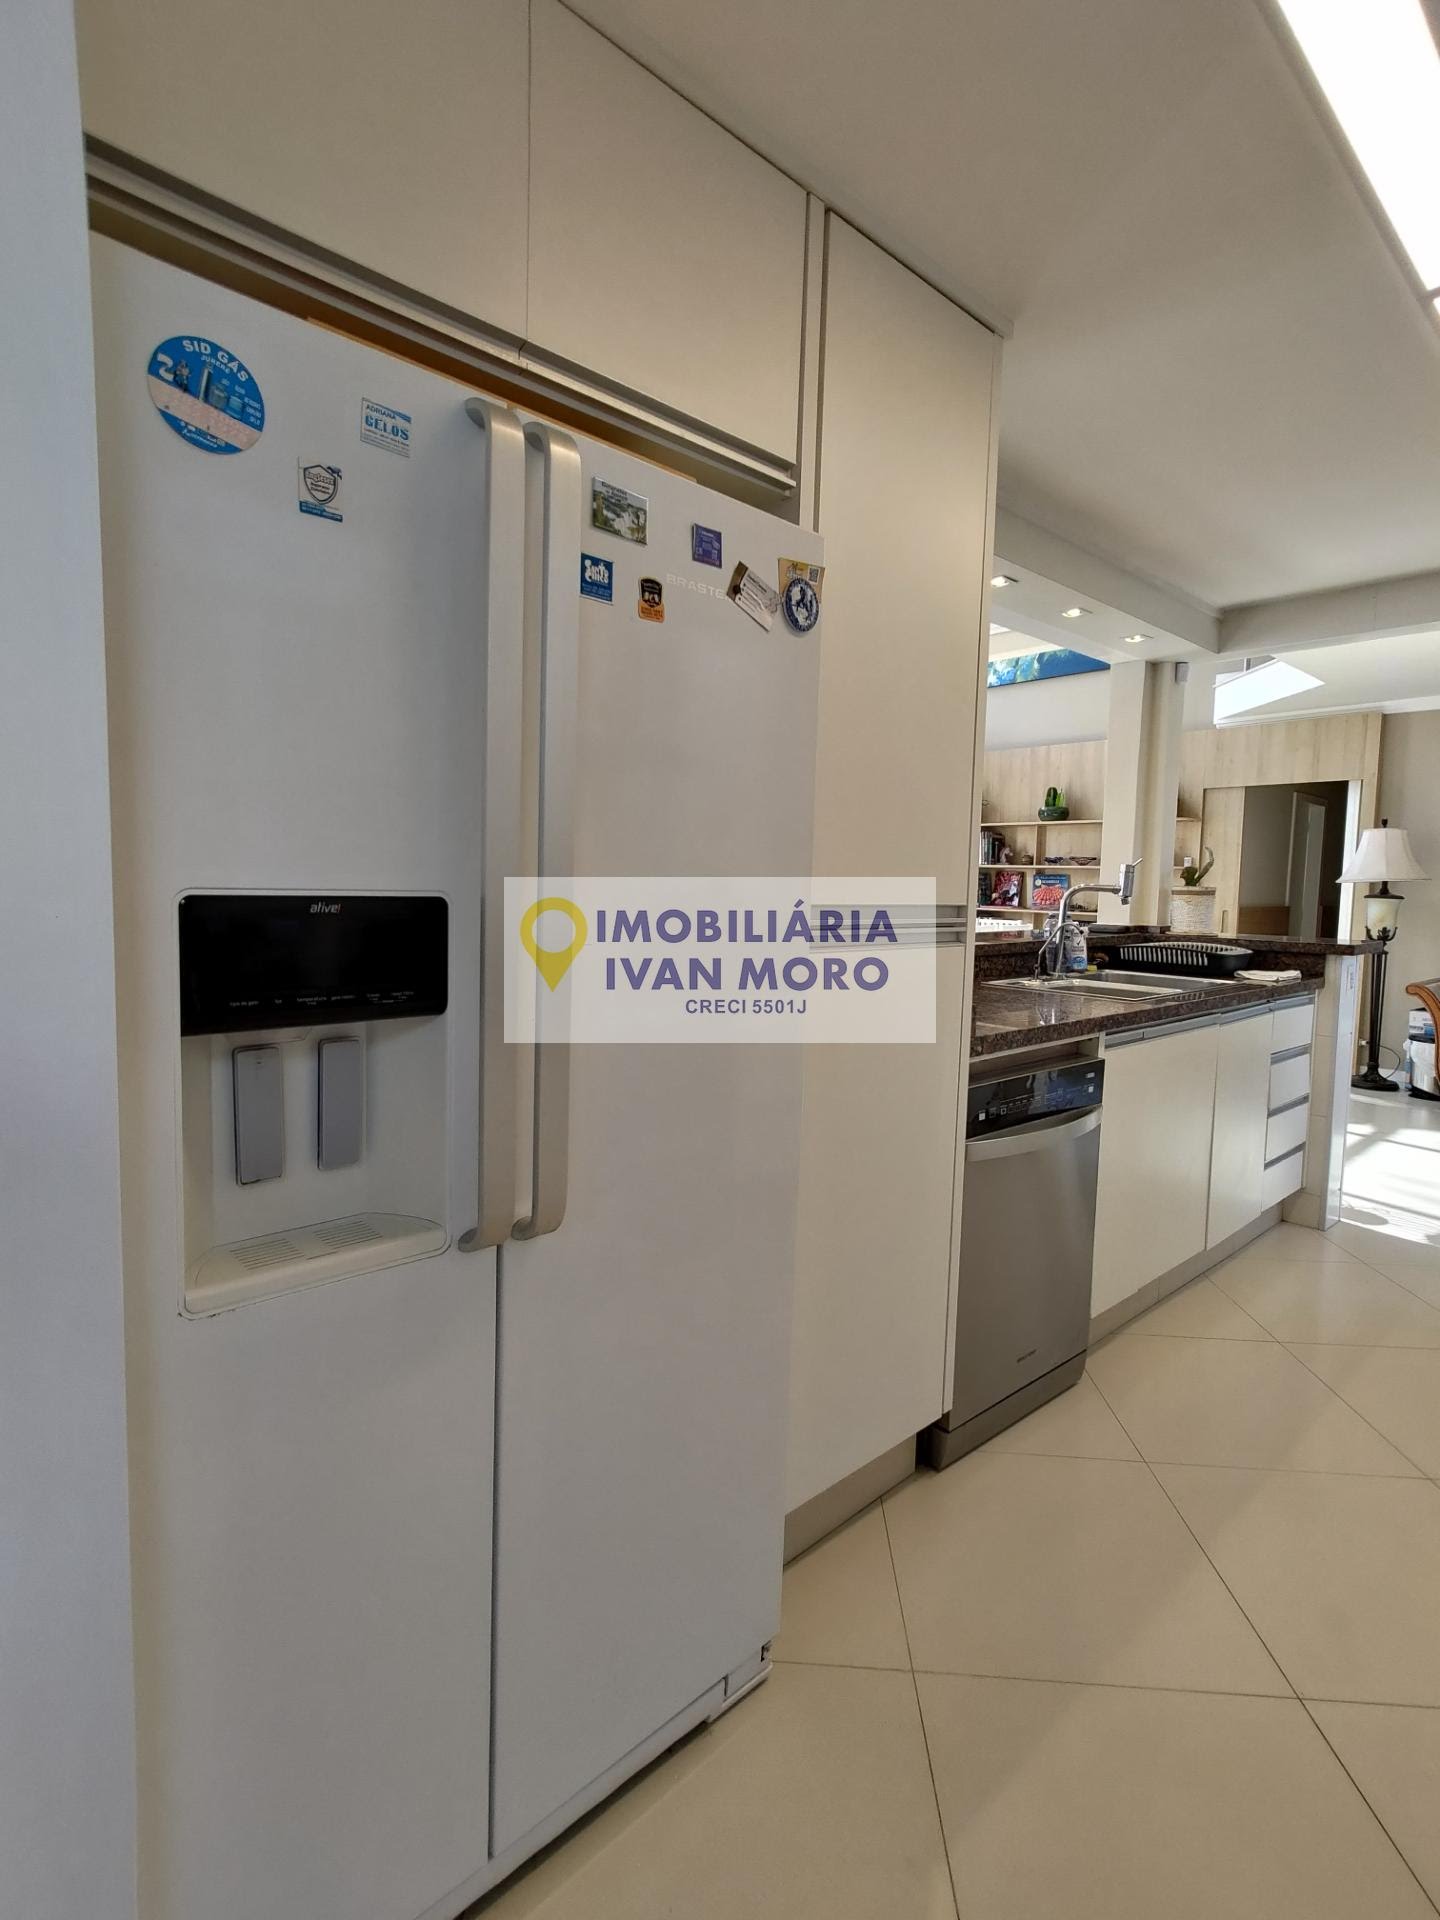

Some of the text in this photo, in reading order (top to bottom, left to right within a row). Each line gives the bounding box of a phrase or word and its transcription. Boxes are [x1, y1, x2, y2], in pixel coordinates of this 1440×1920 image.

[182, 340, 211, 354] SID
[366, 403, 396, 419] ADRIANA
[365, 415, 409, 441] GELOS
